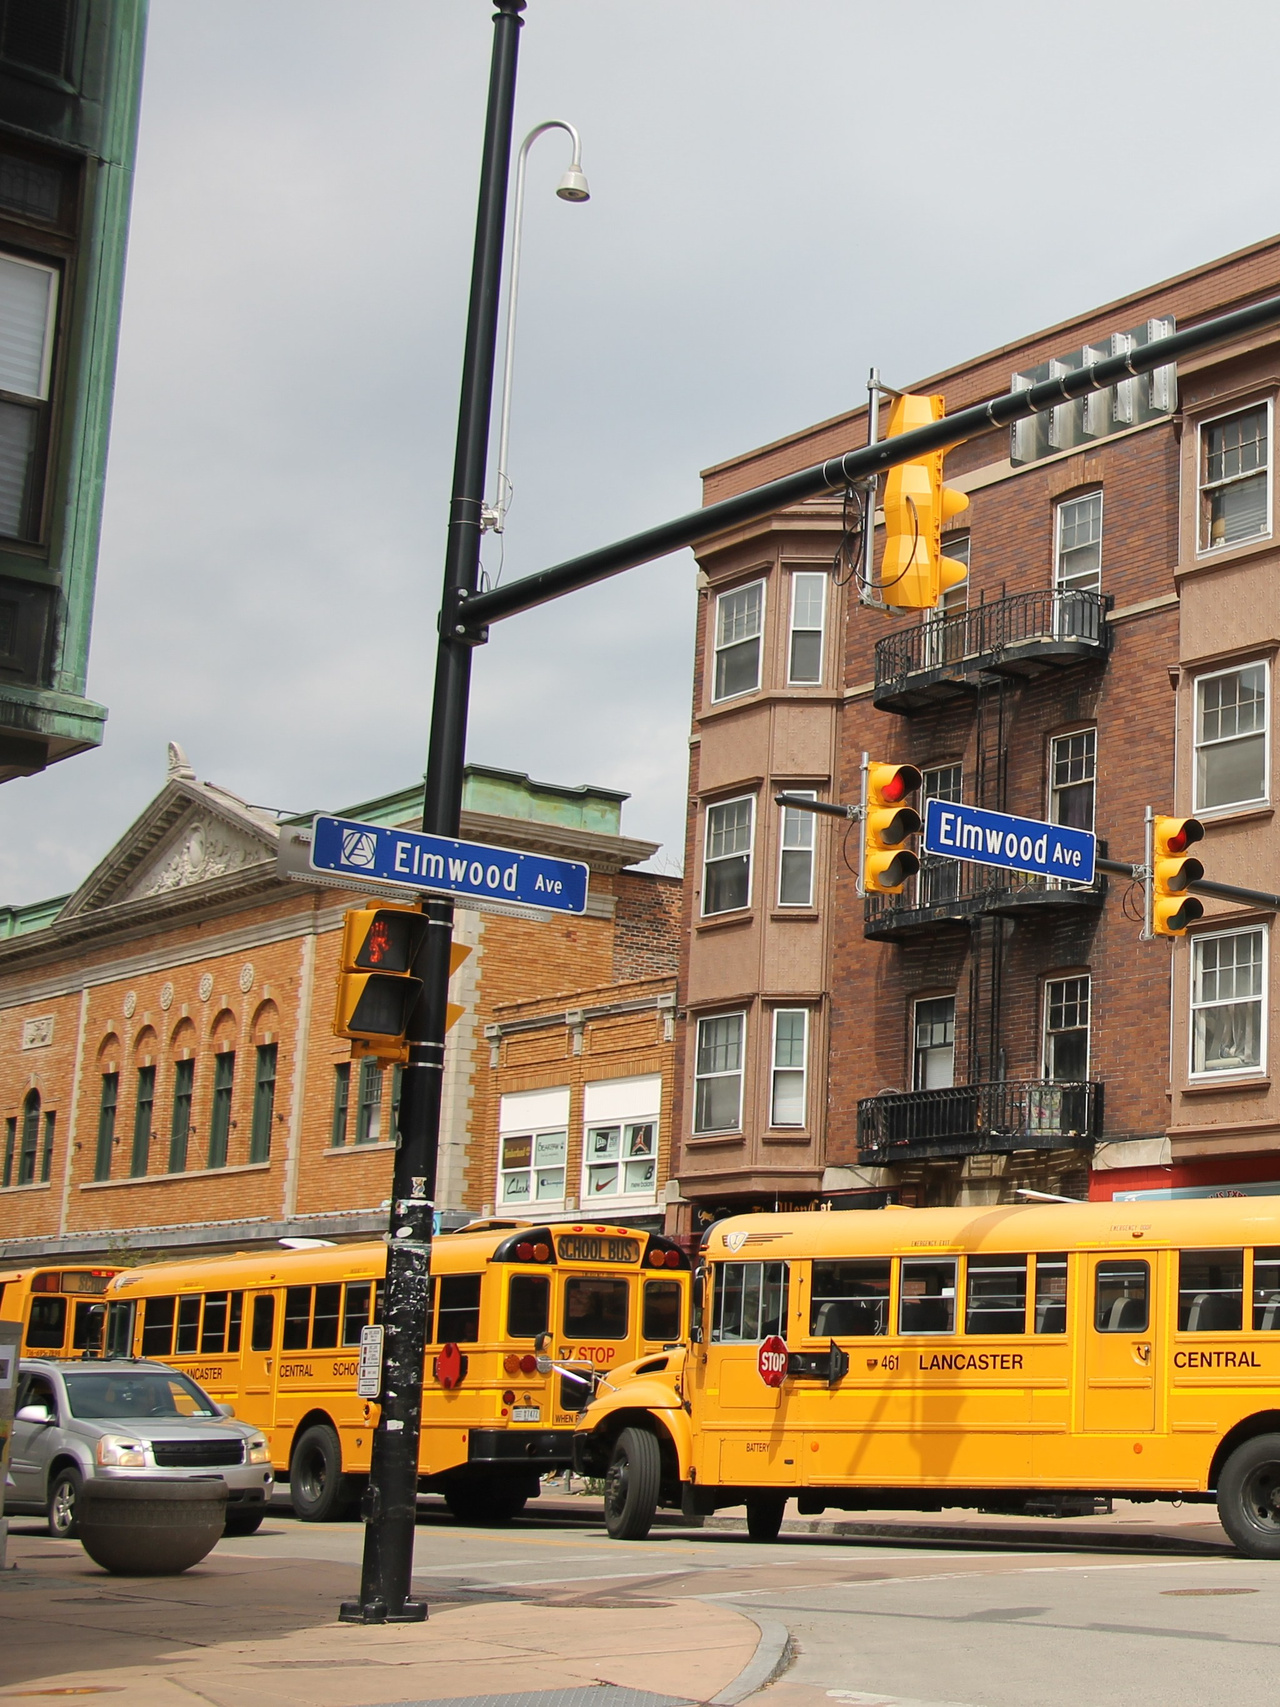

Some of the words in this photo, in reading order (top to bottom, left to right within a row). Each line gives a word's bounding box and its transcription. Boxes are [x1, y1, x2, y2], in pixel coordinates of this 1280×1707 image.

[939, 811, 1048, 865] Elmwood
[1052, 842, 1082, 868] Ave
[394, 841, 519, 892] Elmwood
[534, 874, 563, 895] Ave
[560, 1238, 605, 1260] SCHOOL
[608, 1240, 632, 1261] BUS
[578, 1346, 615, 1363] STOP
[761, 1352, 786, 1372] STOP
[881, 1354, 900, 1371] 461
[918, 1353, 1024, 1370] LANCASTER
[1173, 1351, 1262, 1368] CENTRAL
[279, 1364, 314, 1378] CENTRAL
[555, 1414, 574, 1423] WHEN
[746, 1442, 770, 1453] BATTERY
